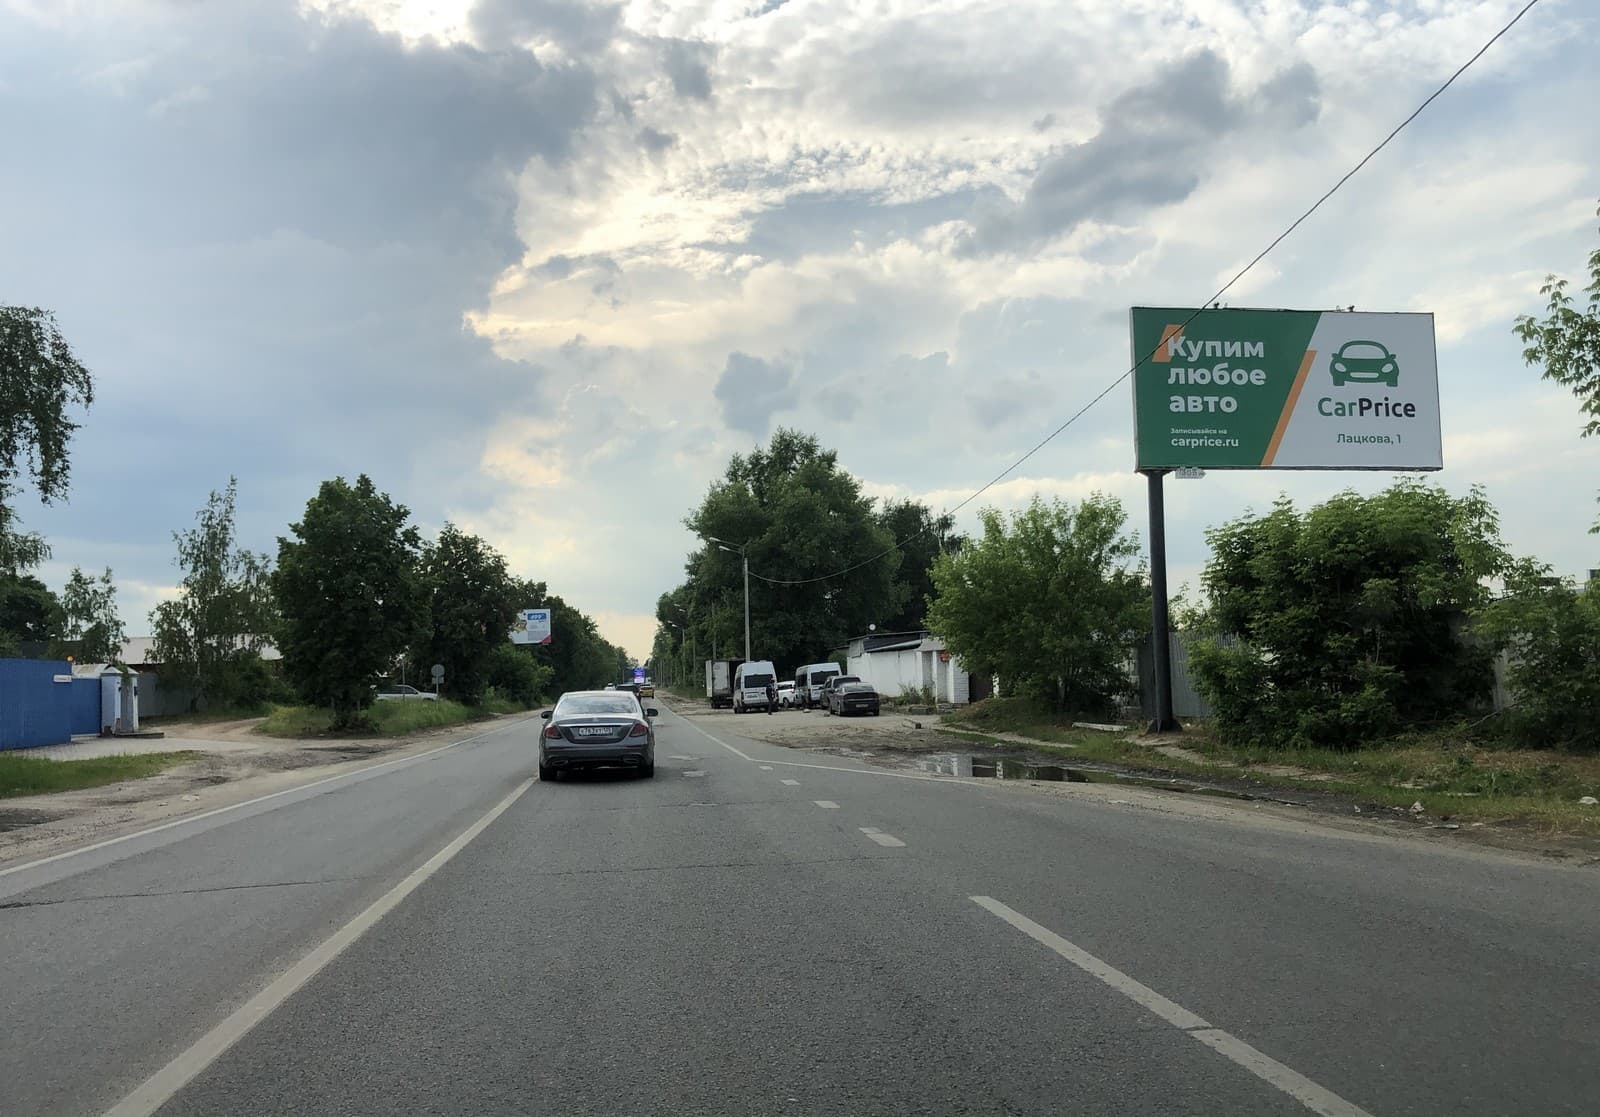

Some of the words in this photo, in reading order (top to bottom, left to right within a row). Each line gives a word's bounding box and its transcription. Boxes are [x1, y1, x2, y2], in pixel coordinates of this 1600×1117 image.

[1168, 336, 1264, 362] Купим
[1168, 363, 1266, 385] любое
[1169, 395, 1238, 413] авто
[1318, 397, 1416, 418] CarPrice
[1171, 436, 1239, 449] carprice.ru
[1337, 433, 1394, 445] Лацкова,
[1396, 434, 1402, 444] 1
